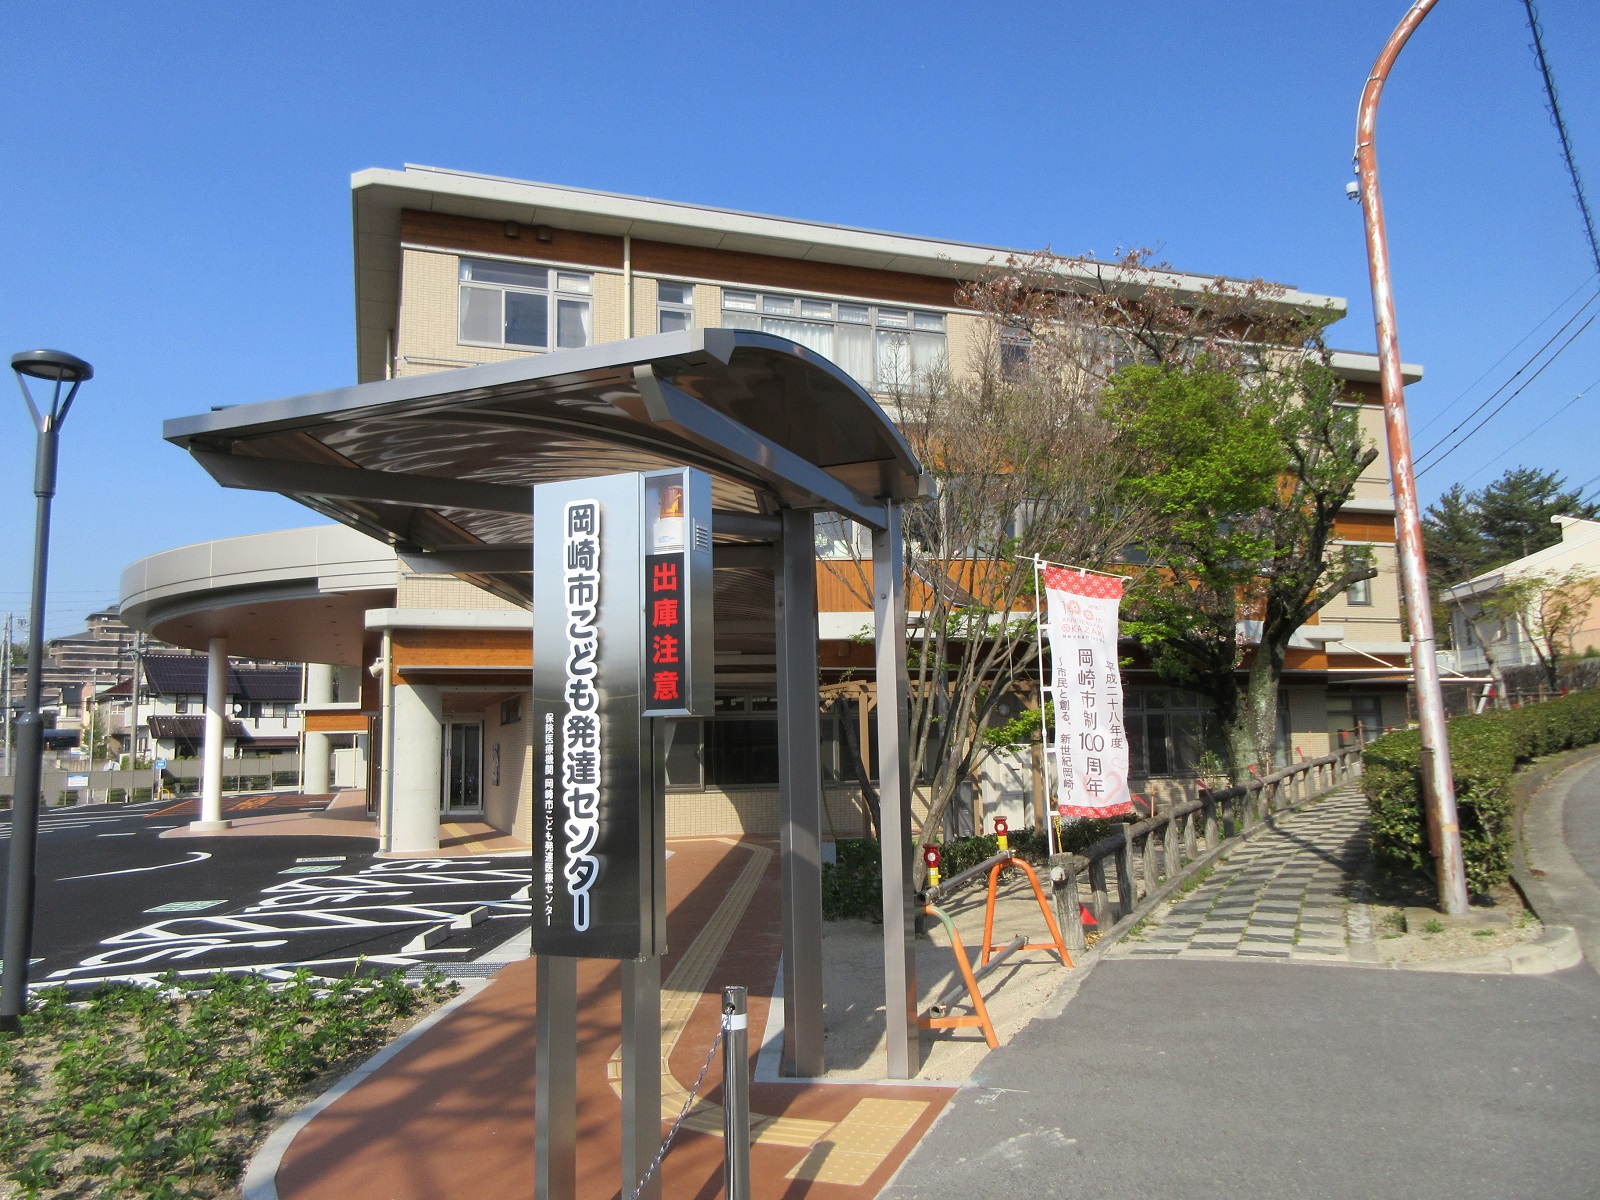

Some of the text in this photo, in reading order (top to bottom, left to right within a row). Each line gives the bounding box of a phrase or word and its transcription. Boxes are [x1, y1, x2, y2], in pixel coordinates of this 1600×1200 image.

[652, 562, 679, 700] 出庫注意
[563, 499, 601, 931] 岡崎市こども発達センター
[1077, 648, 1105, 797] 岡崎市制100周年
[1105, 661, 1123, 749] 平成二十八年度
